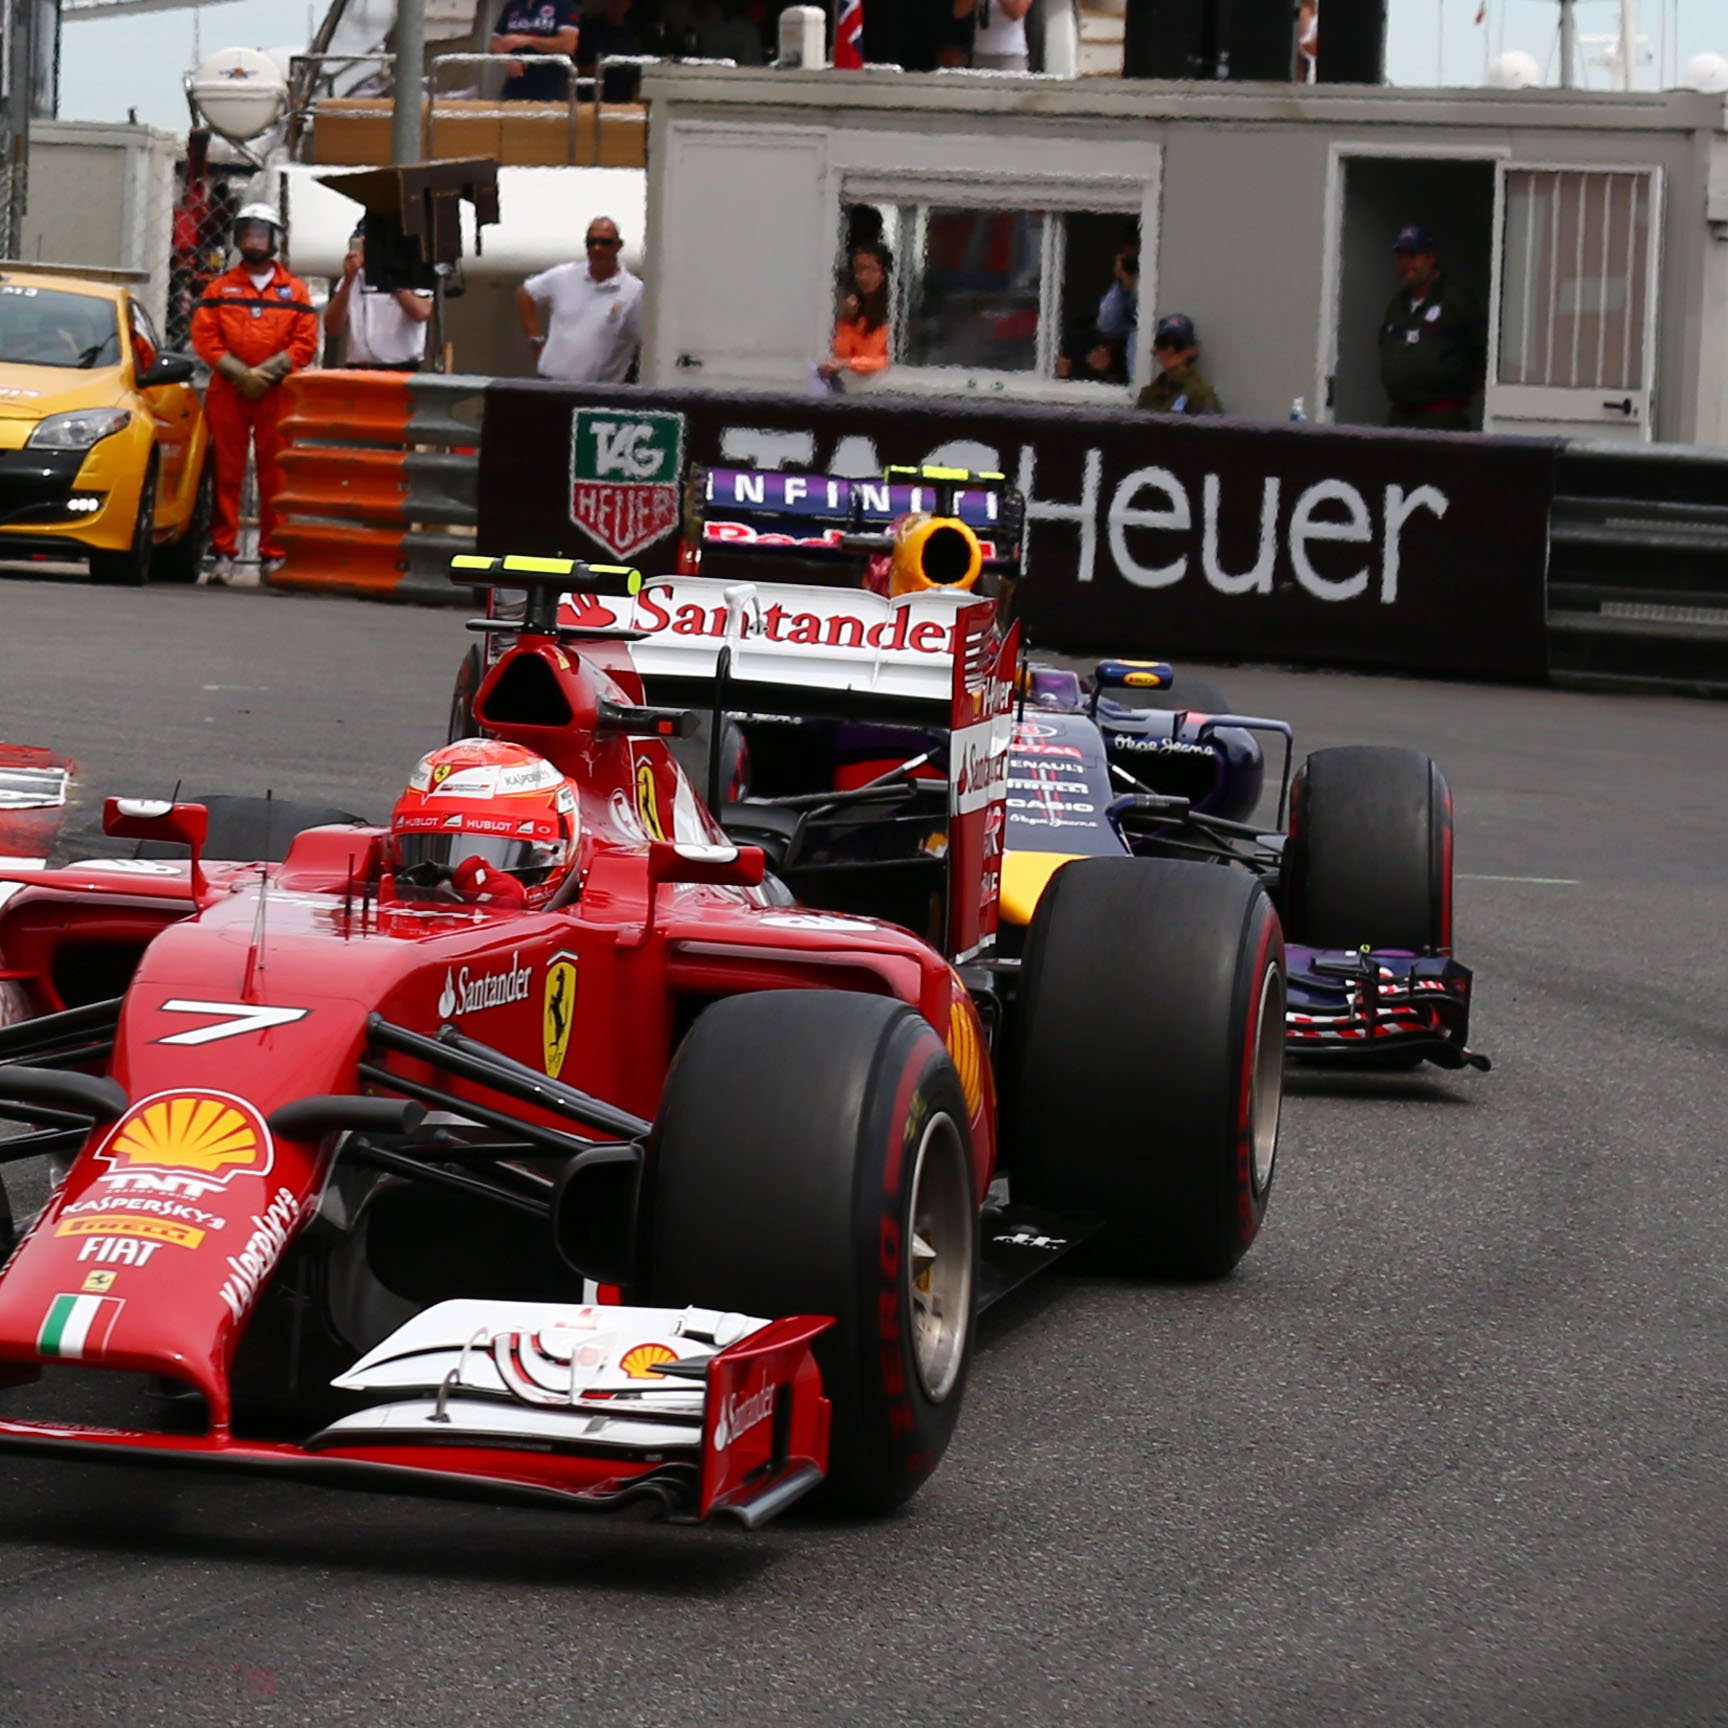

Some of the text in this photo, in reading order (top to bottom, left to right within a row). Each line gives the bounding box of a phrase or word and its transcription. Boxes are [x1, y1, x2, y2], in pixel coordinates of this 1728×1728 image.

[590, 422, 665, 477] TAG
[577, 486, 679, 549] HEUER
[1017, 443, 1449, 604] Heuer
[1010, 759, 1084, 774] ENAULT
[467, 819, 512, 831] HUBLOT
[455, 950, 533, 1015] Santander
[152, 998, 312, 1045] 7
[96, 1174, 227, 1198] TNT
[76, 1236, 164, 1268] FIAT
[727, 1368, 777, 1445] Santander
